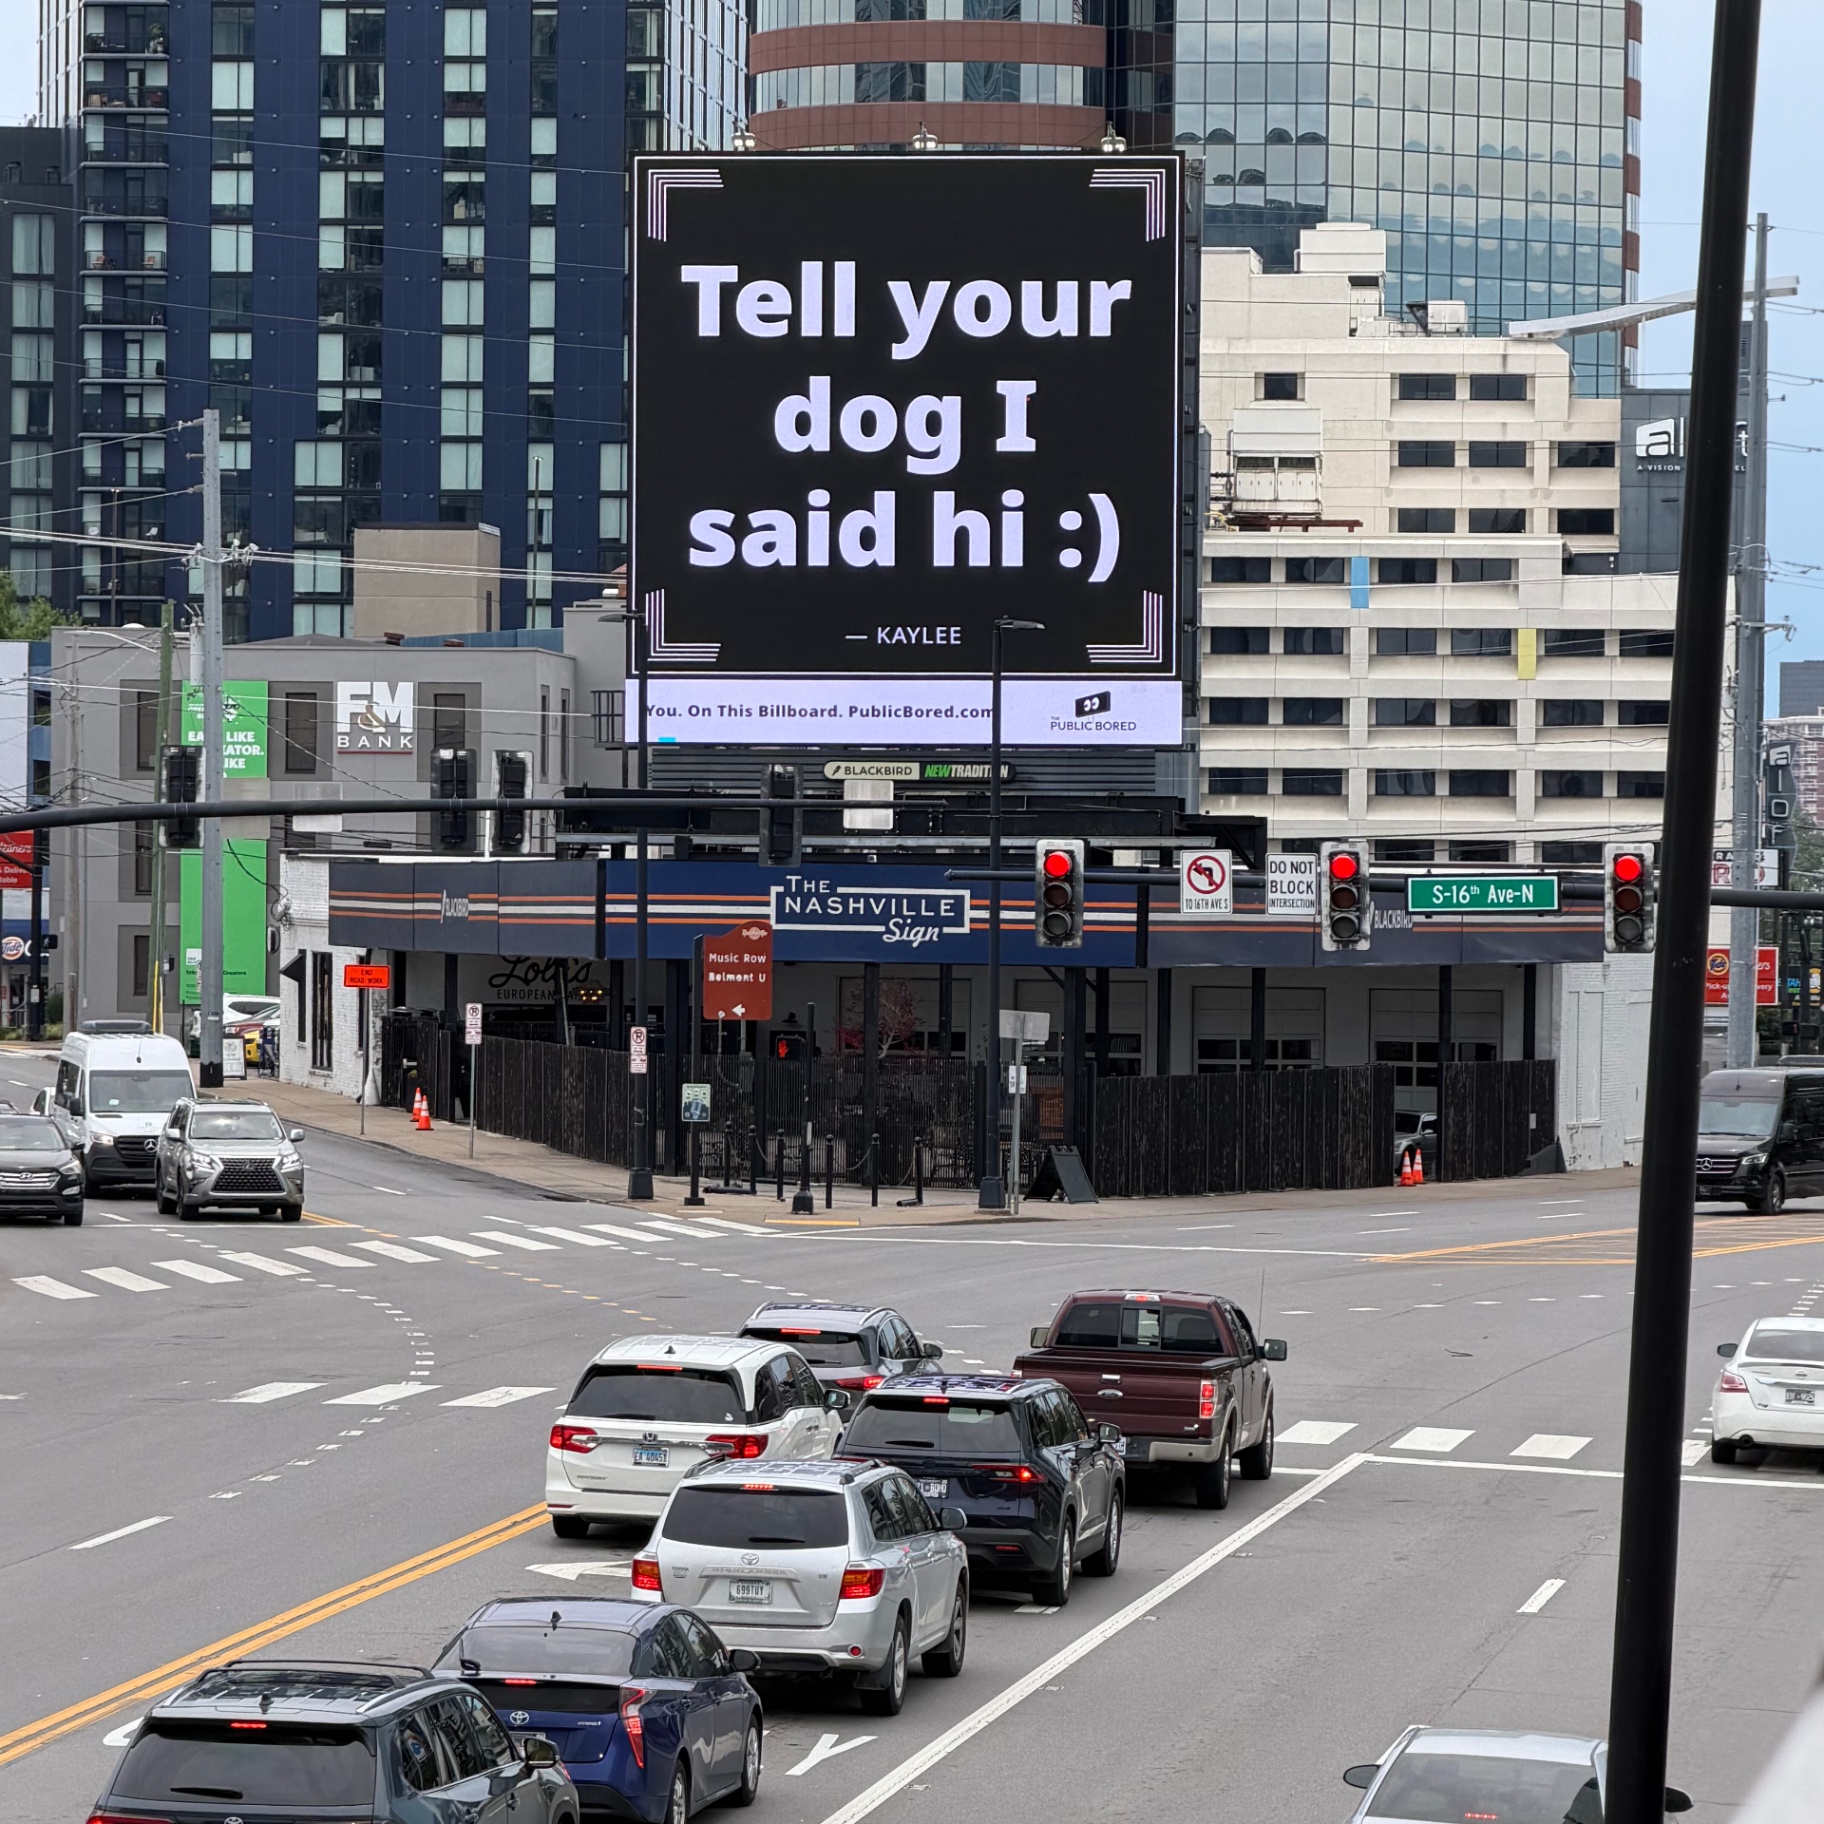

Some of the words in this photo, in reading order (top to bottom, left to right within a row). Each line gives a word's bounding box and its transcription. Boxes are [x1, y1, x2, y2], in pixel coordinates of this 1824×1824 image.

[681, 260, 856, 337] Tell
[887, 280, 1133, 360] your
[774, 375, 962, 475] dog
[996, 380, 1037, 452] I
[1636, 416, 1749, 457] alt
[688, 489, 896, 567] said
[932, 489, 1024, 567] hi
[1058, 493, 1120, 582] :)
[877, 626, 961, 645] KAYLEE
[337, 681, 413, 732] F&M
[646, 704, 682, 717] You.
[688, 705, 712, 718] On
[718, 704, 752, 718] This
[759, 705, 843, 718] Billboard.
[849, 704, 993, 719] PublicBored.com
[1050, 721, 1092, 731] PUBLIC
[1095, 721, 1137, 731] BORED
[188, 731, 204, 742] EA
[226, 731, 255, 742] LIKE
[337, 735, 413, 748] BANK
[222, 758, 246, 768] IKE
[844, 765, 912, 776] BLACKBIRD
[1269, 861, 1287, 874] DO
[1290, 861, 1315, 875] NOT
[1269, 880, 1315, 895] BLOCK
[1432, 884, 1480, 904] S-16th
[1487, 884, 1534, 904] Ave-N
[785, 896, 955, 917] NASHVILLE
[1185, 898, 1193, 910] TO
[1194, 898, 1209, 910] 16TH
[1210, 898, 1223, 910] AVE
[1224, 898, 1228, 910] S
[1269, 898, 1315, 909] INTERSECTION
[1374, 909, 1413, 929] BLACKBIRD
[882, 918, 940, 948] Sign
[2, 942, 22, 953] Tide
[709, 953, 739, 963] Music
[744, 953, 767, 963] Row
[1710, 960, 1726, 971] Tide
[708, 972, 754, 982] Belmont
[758, 974, 766, 982] U
[497, 989, 555, 1000] EUROPEAN
[736, 1585, 764, 1596] 699TUY
